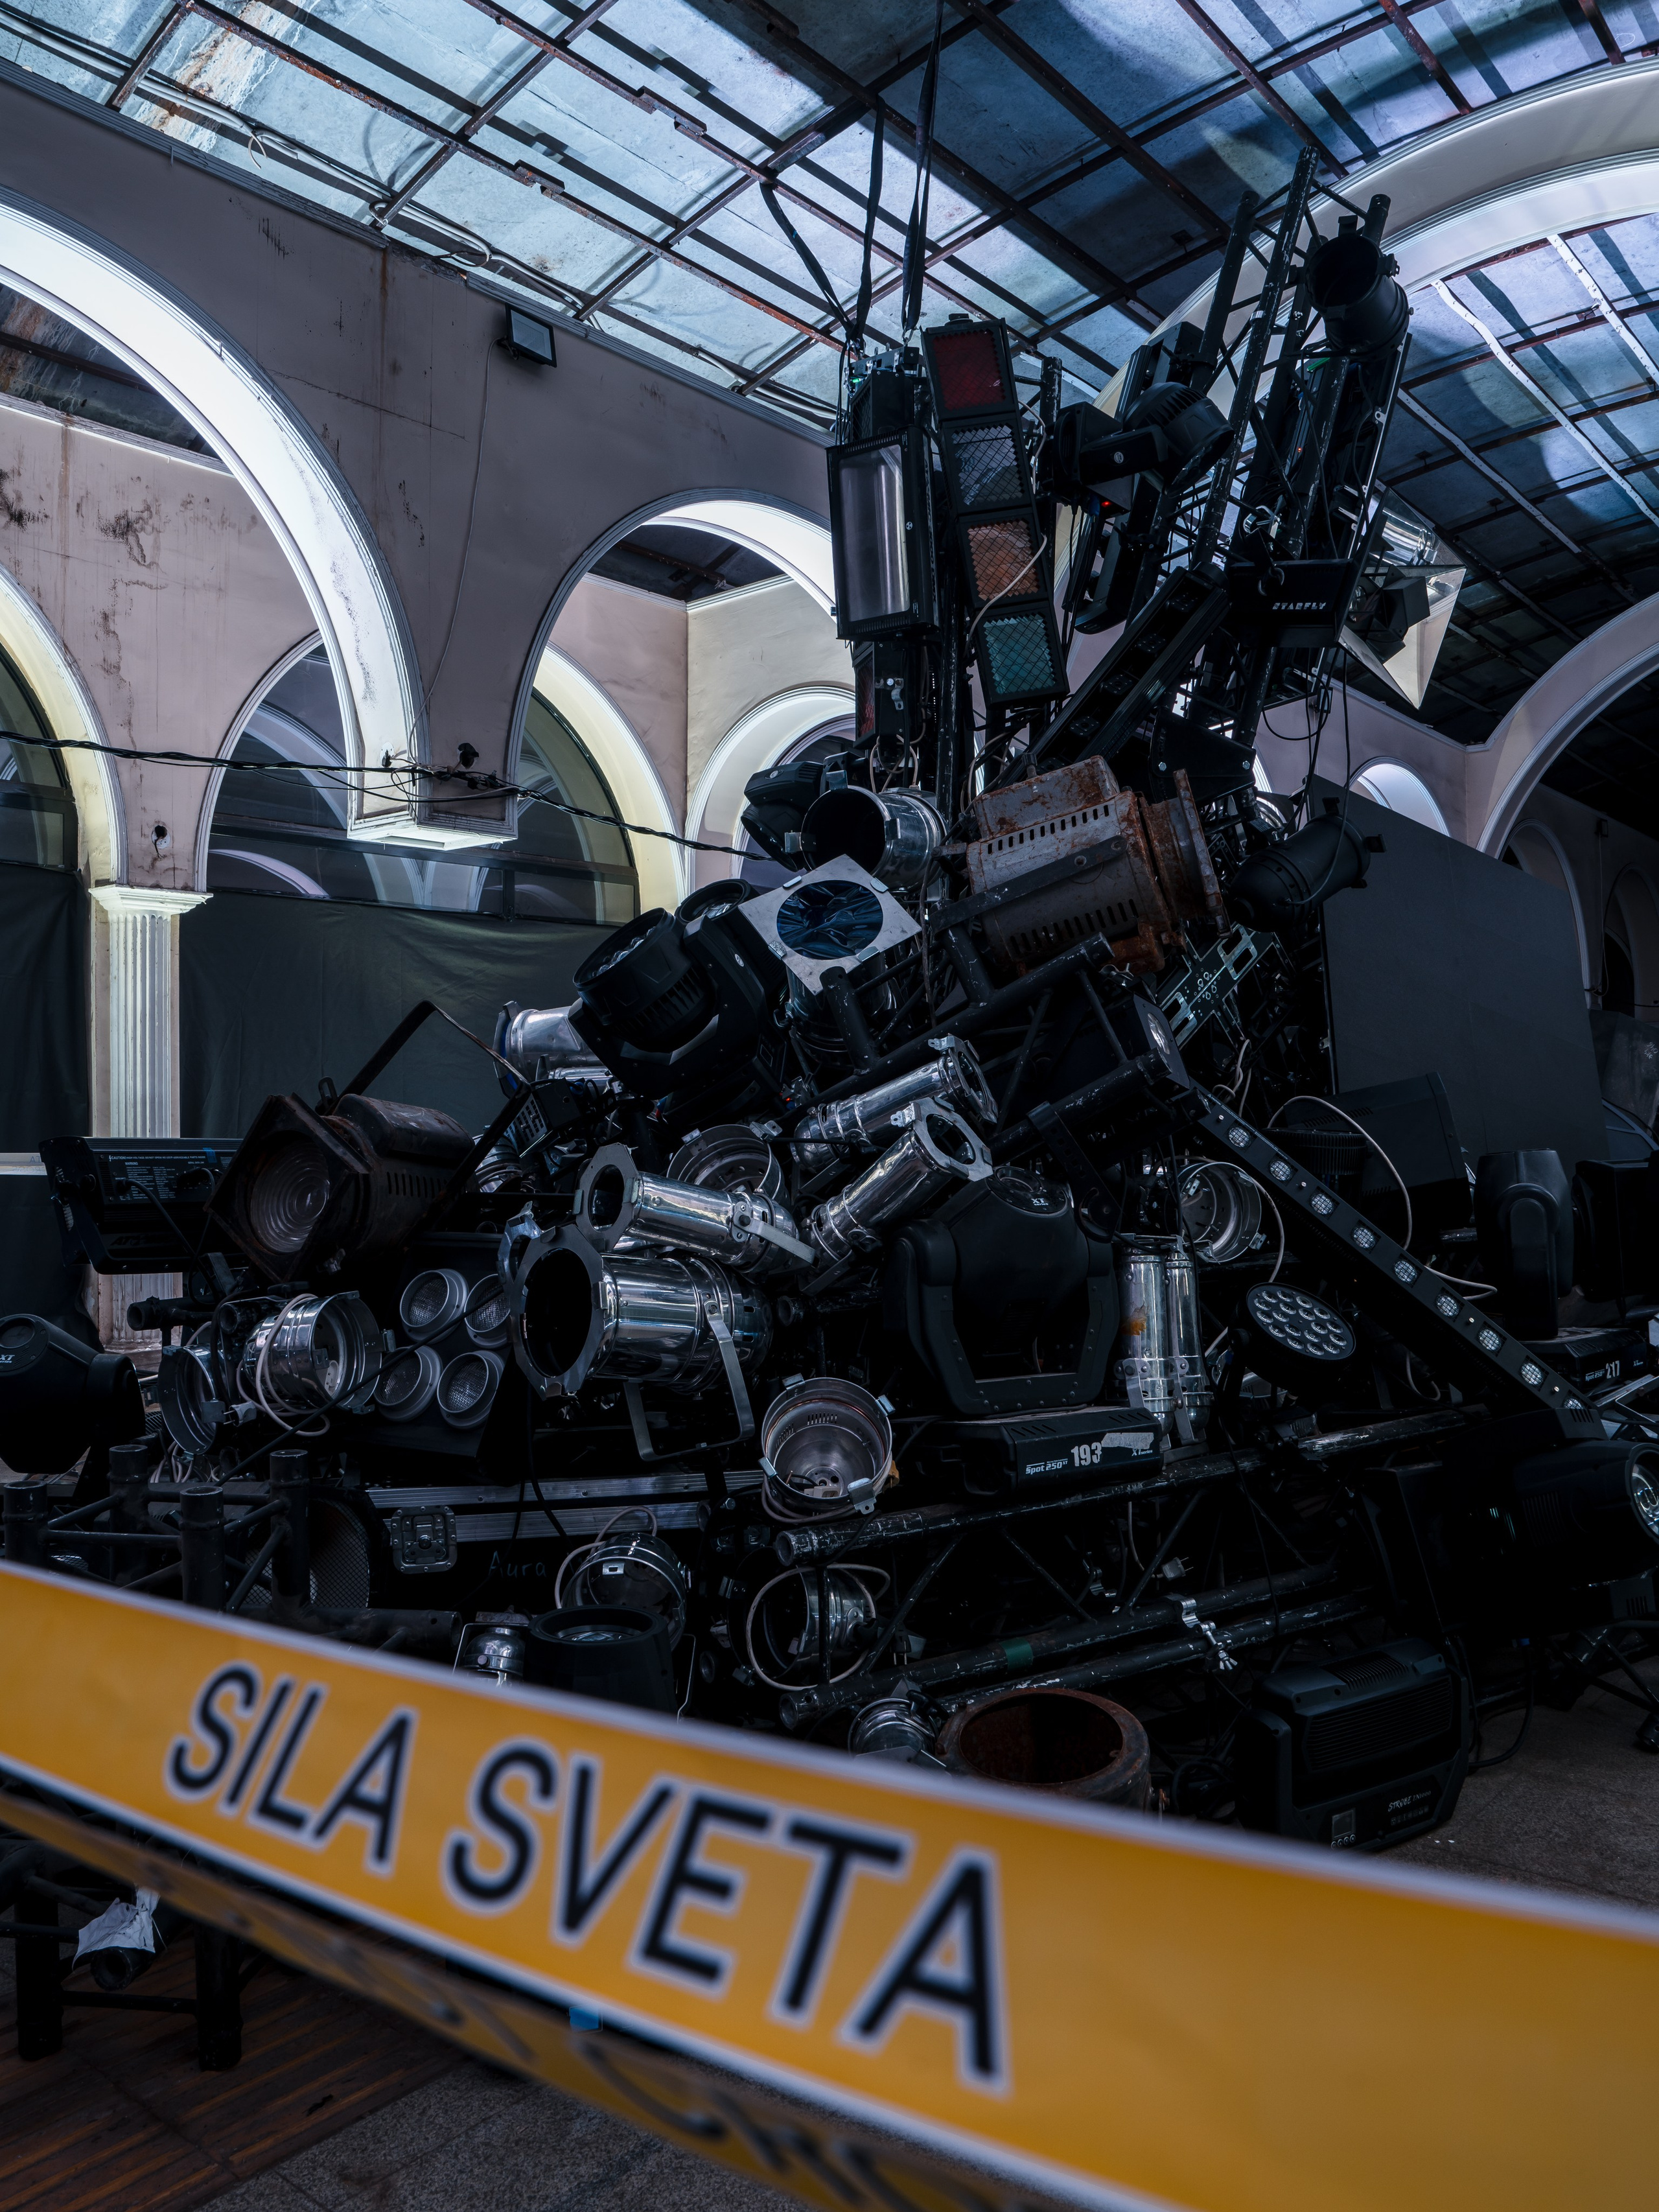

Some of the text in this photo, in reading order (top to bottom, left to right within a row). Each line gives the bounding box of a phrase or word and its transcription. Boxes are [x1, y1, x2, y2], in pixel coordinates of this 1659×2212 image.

[1606, 1360, 1619, 1379] 217
[1071, 1442, 1102, 1467] 193
[1025, 1465, 1045, 1475] Spot
[488, 1550, 547, 1578] Aura
[1387, 1796, 1412, 1812] STROBE
[167, 1660, 415, 1870] SILA
[443, 1743, 1006, 2090] SVETA
